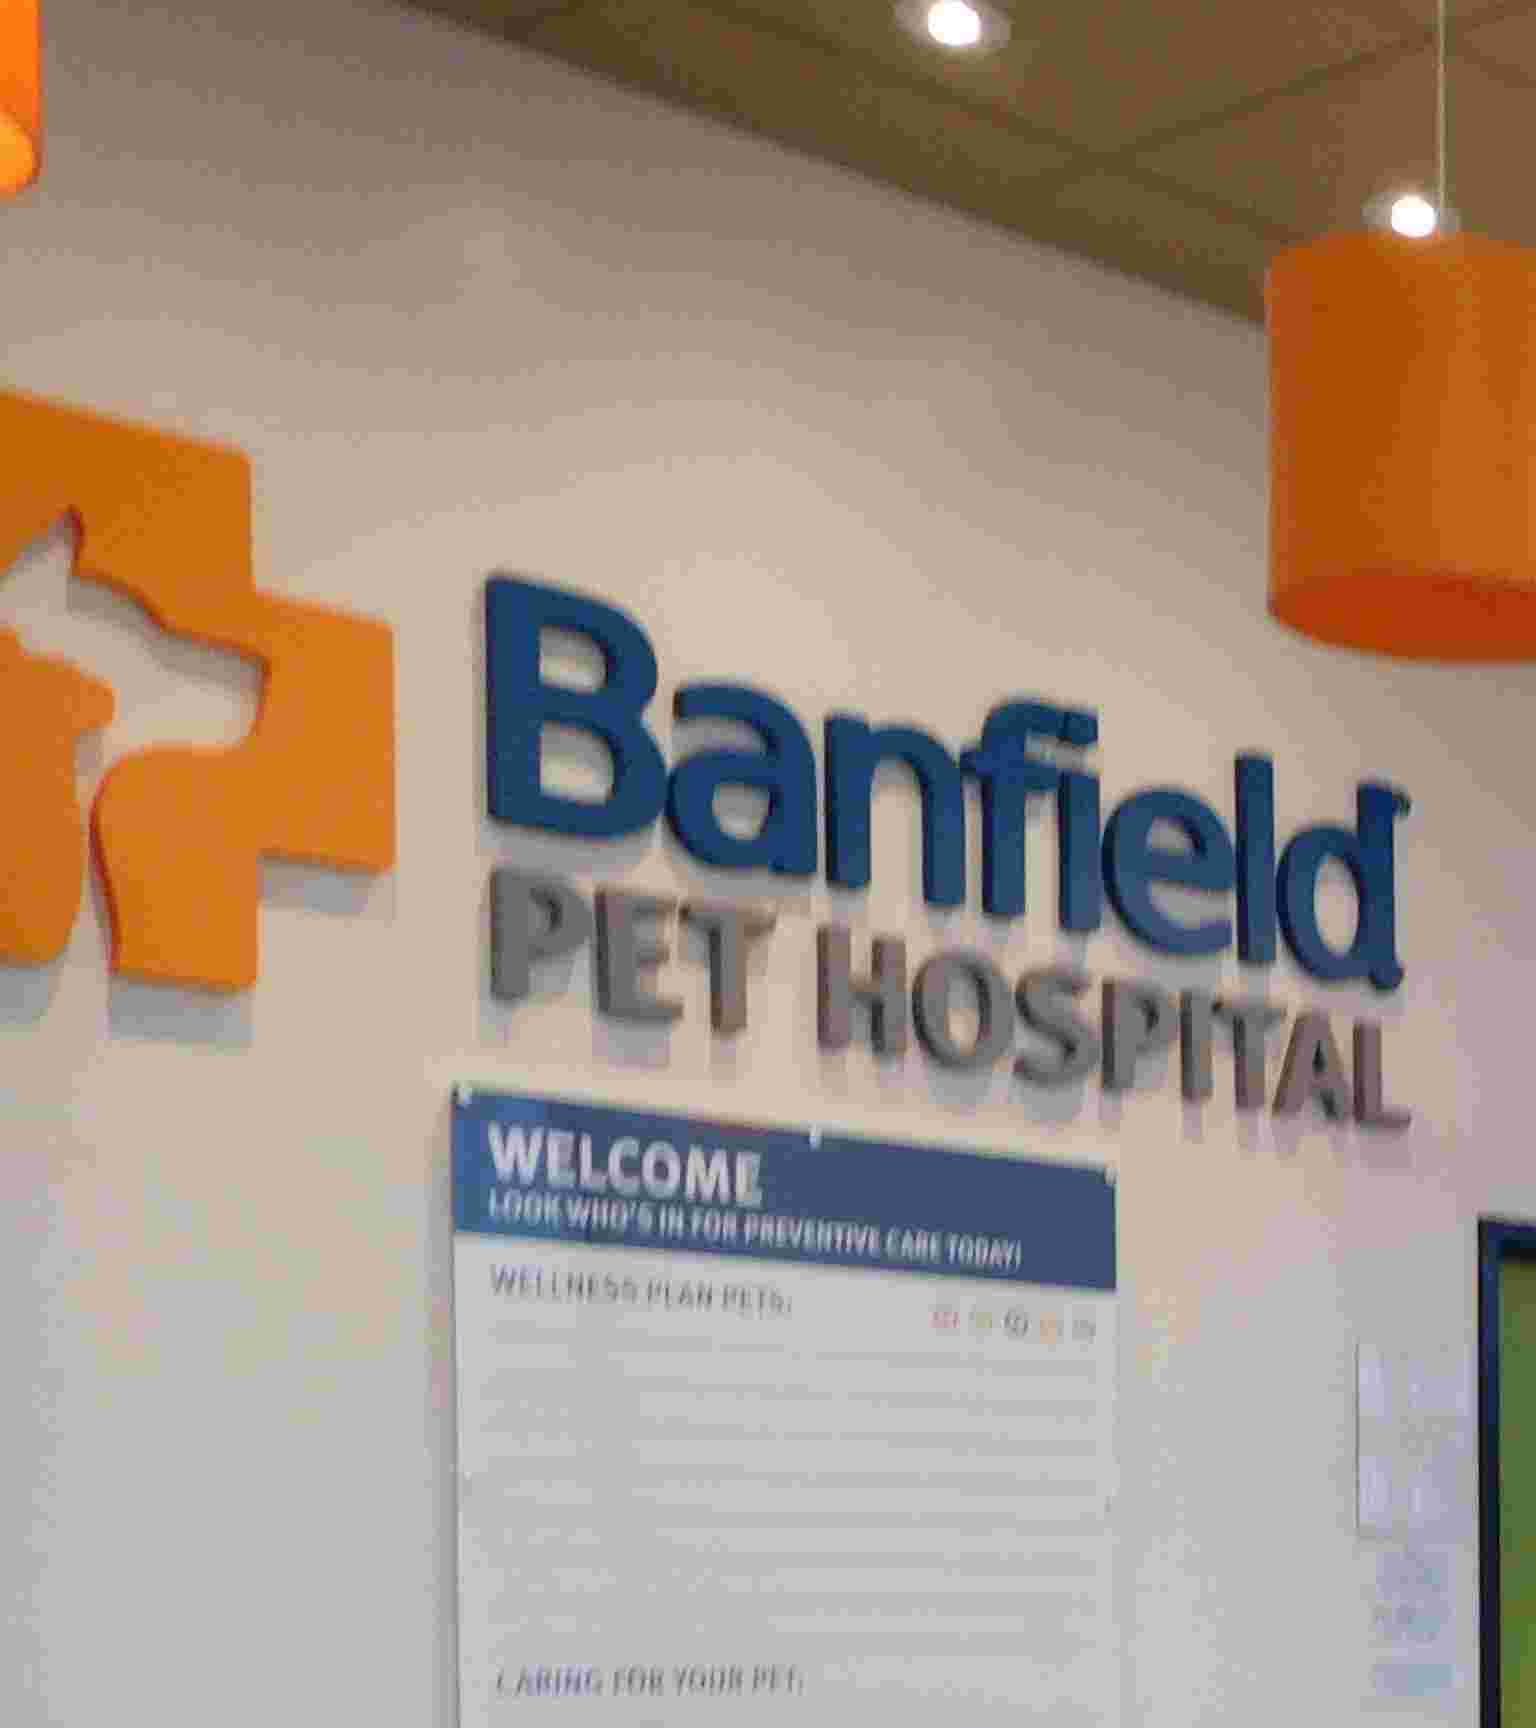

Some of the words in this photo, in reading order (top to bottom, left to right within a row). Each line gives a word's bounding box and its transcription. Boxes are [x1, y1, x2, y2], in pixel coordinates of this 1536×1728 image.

[484, 573, 1410, 990] Banfield
[488, 866, 776, 1036] PET
[817, 924, 1410, 1130] HOSPITAL
[487, 1122, 763, 1207] WELCOME
[489, 1187, 561, 1226] LOOK
[567, 1194, 653, 1233] WHO'S
[659, 1200, 685, 1238] IN
[692, 1207, 737, 1245] FOR
[744, 1212, 880, 1257] PREVENTIVE
[886, 1225, 940, 1264] CARE
[490, 1264, 639, 1303] WELLNESS
[647, 1279, 713, 1311] PLAN
[496, 1663, 602, 1697] CARING
[612, 1663, 665, 1697] FOR
[672, 1663, 744, 1697] YOUR
